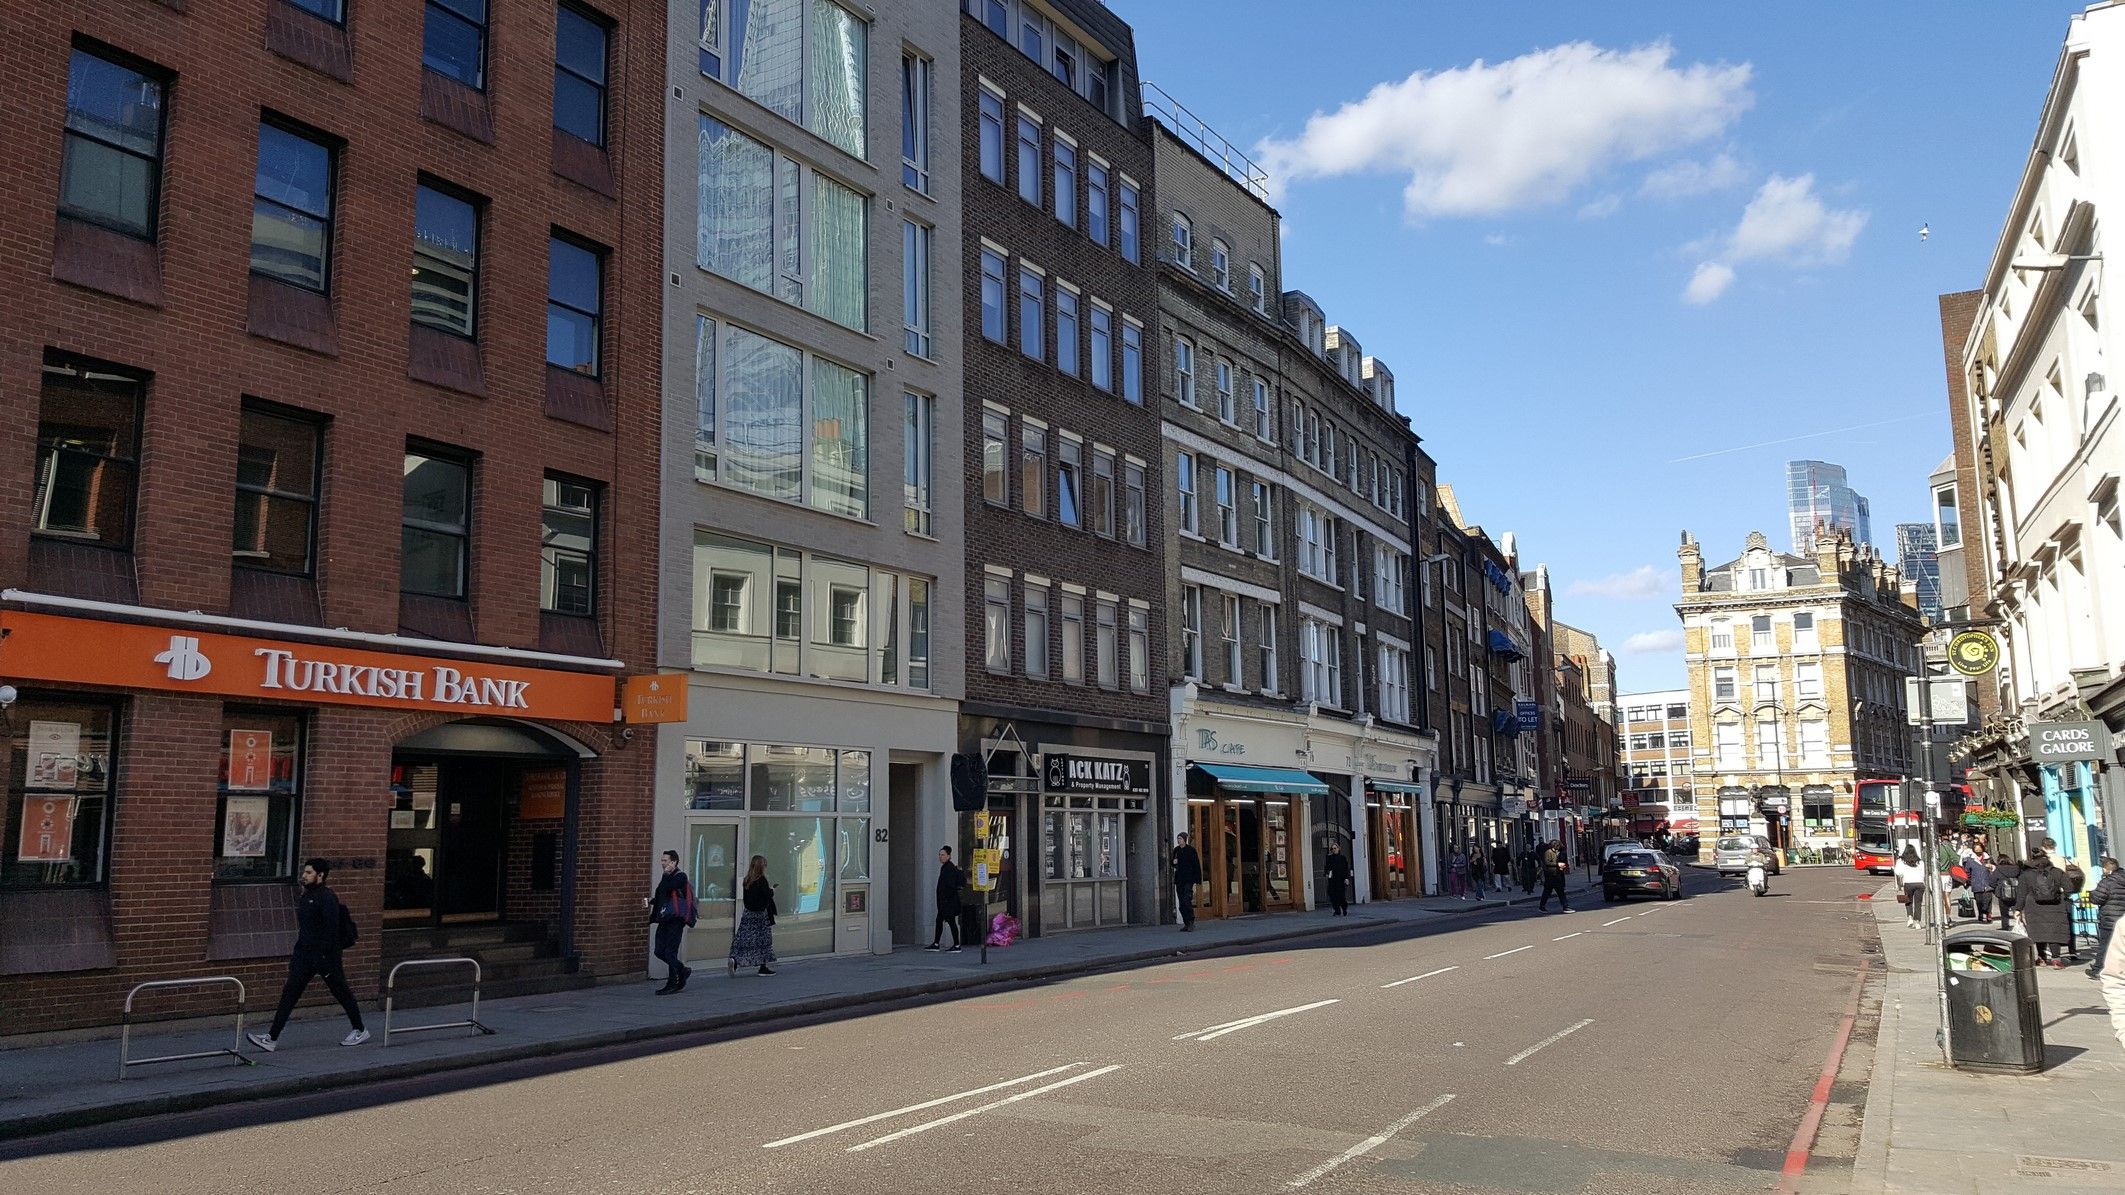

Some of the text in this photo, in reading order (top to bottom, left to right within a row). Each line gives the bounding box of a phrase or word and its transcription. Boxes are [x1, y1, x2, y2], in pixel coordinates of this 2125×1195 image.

[254, 648, 530, 709] TURKISH BANK
[637, 694, 672, 705] TURKISH
[641, 708, 666, 719] BANK
[1195, 728, 1218, 751] TAS
[2042, 728, 2090, 742] CARDS
[1221, 743, 1246, 755] CAFE
[2040, 741, 2095, 755] GALORE
[1094, 761, 1123, 781] KATZ
[1075, 781, 1095, 790] Property
[1095, 782, 1122, 790] Management
[875, 828, 888, 842] 82
